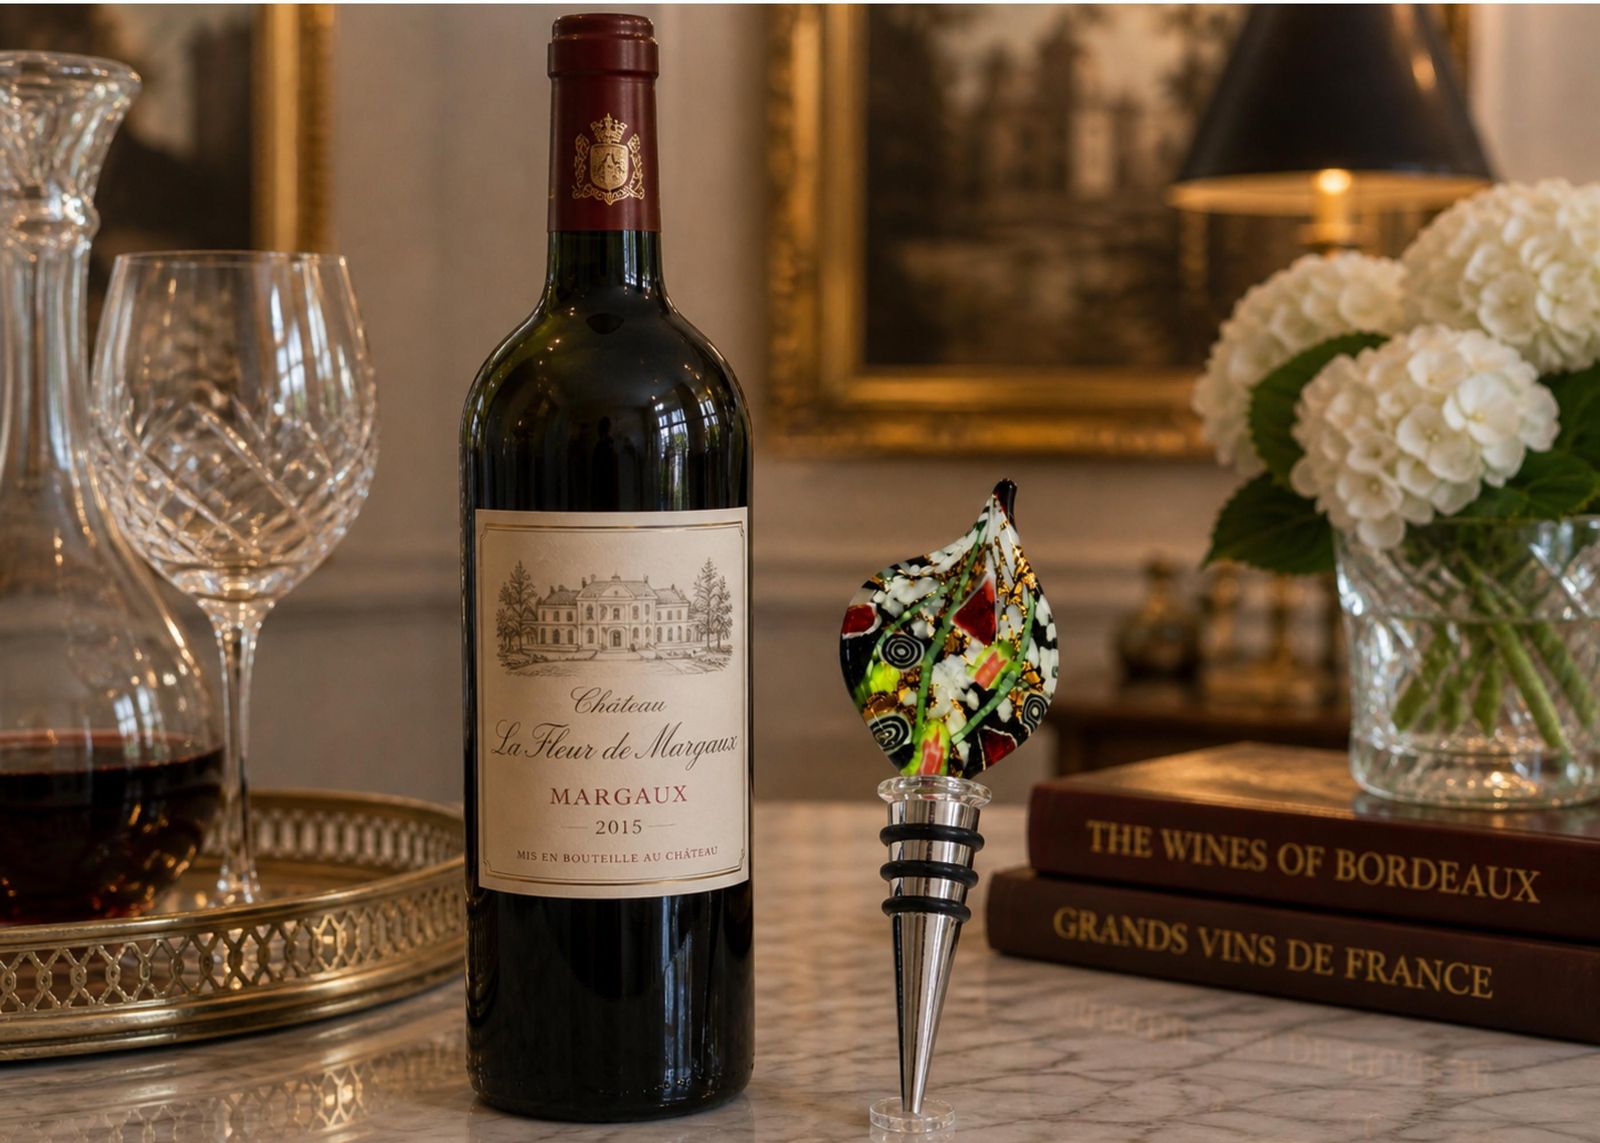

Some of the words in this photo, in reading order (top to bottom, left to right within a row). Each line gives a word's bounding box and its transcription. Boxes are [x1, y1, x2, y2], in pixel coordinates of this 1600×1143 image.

[490, 719, 522, 756] La
[524, 722, 596, 760] Fleur
[602, 732, 632, 760] de
[634, 721, 738, 771] Margaux
[549, 785, 688, 806] MARGAUX
[595, 820, 643, 835] 2015
[516, 850, 538, 861] MIS
[542, 852, 558, 862] EN
[563, 853, 640, 864] BOUTEILLE
[643, 851, 662, 862] AU
[1086, 820, 1153, 859] THE
[1161, 829, 1267, 872] WINES
[1277, 842, 1325, 880] OF
[1335, 848, 1541, 904] BORDEAUX
[1053, 906, 1189, 954] GRANDS
[1197, 926, 1276, 967] VINS
[1287, 939, 1334, 976] DE
[1344, 948, 1494, 999] FRANCE
